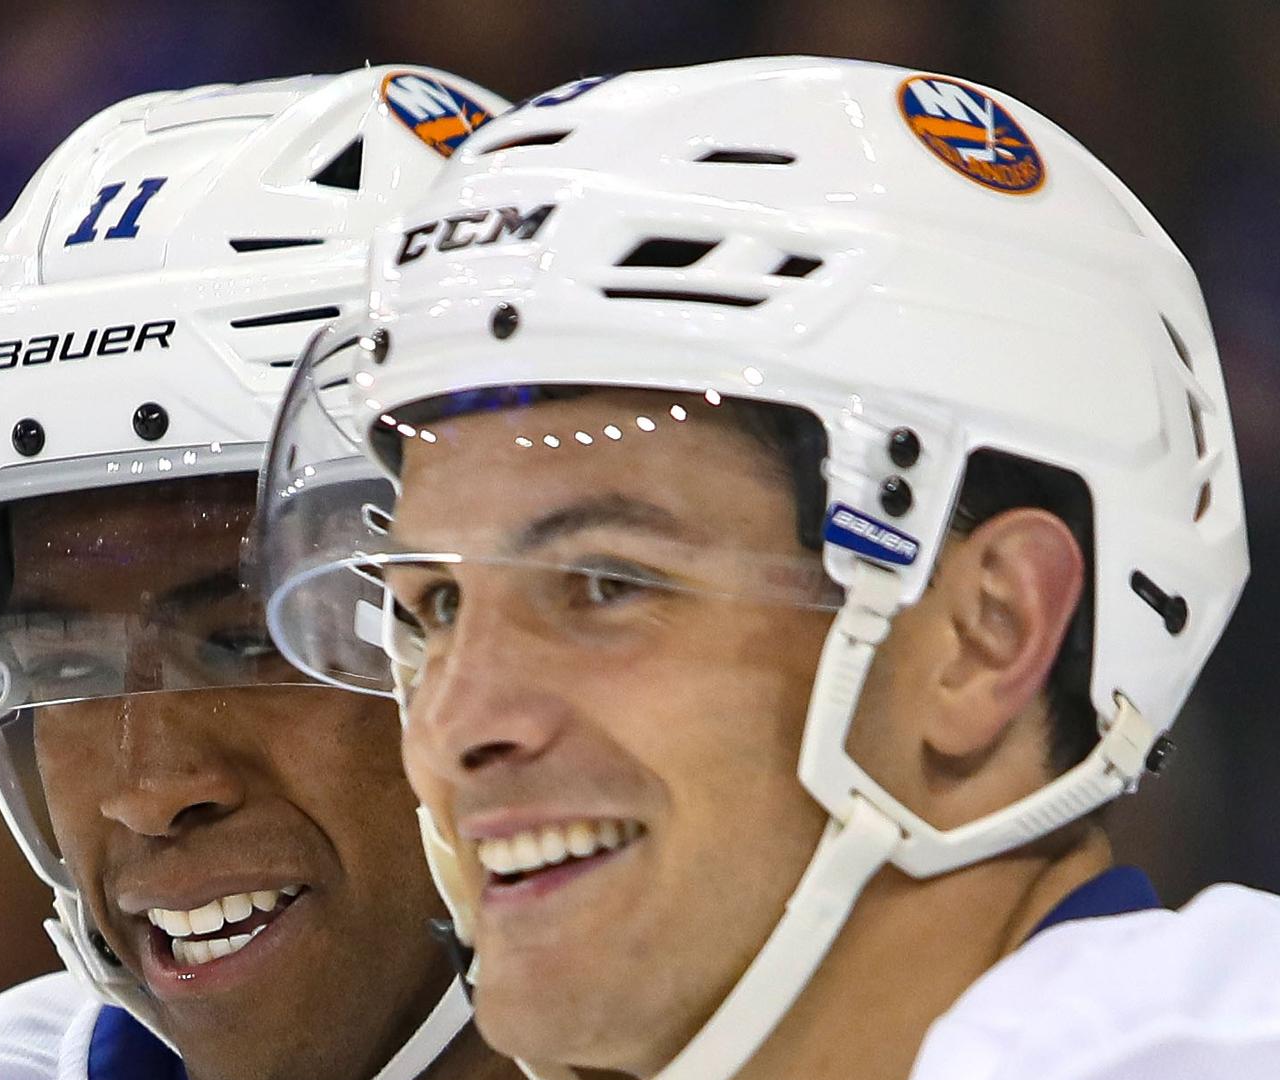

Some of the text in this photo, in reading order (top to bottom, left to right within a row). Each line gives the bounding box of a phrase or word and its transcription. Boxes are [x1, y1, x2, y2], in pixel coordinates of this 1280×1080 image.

[64, 176, 169, 248] 11
[395, 203, 557, 266] CCM
[831, 509, 918, 560] BAUER
